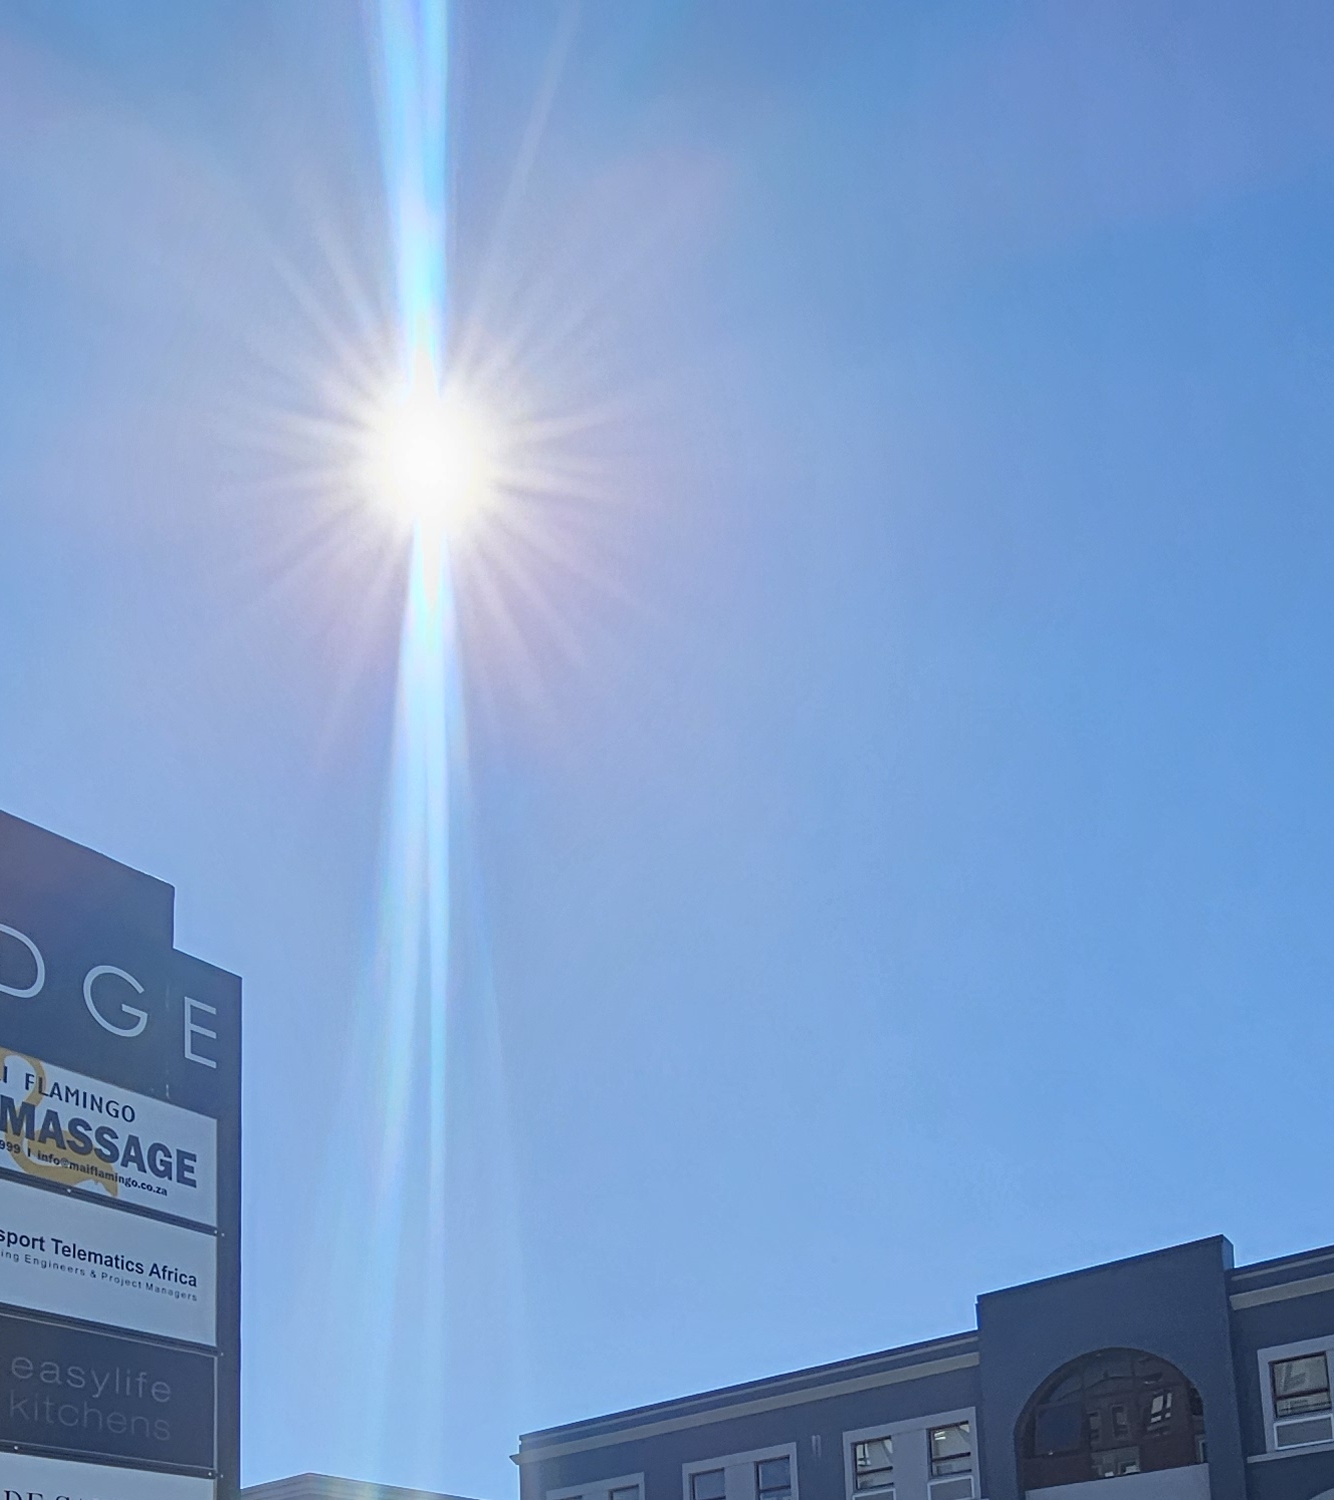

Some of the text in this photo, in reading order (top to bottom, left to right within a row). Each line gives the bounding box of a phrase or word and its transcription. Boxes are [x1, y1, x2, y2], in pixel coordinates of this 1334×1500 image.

[25, 1072, 136, 1123] FLAMINGO
[0, 1094, 197, 1188] MASSAGE
[37, 1151, 168, 1197] info@maiflamingo.co.za
[24, 1254, 86, 1277] Engineers
[89, 1269, 97, 1279] &
[101, 1272, 142, 1289] Project
[145, 1282, 198, 1302] Managers
[51, 1237, 144, 1275] Telematics
[149, 1263, 198, 1288] Africa
[11, 1355, 171, 1402] easylife
[10, 1389, 171, 1442] kitchens
